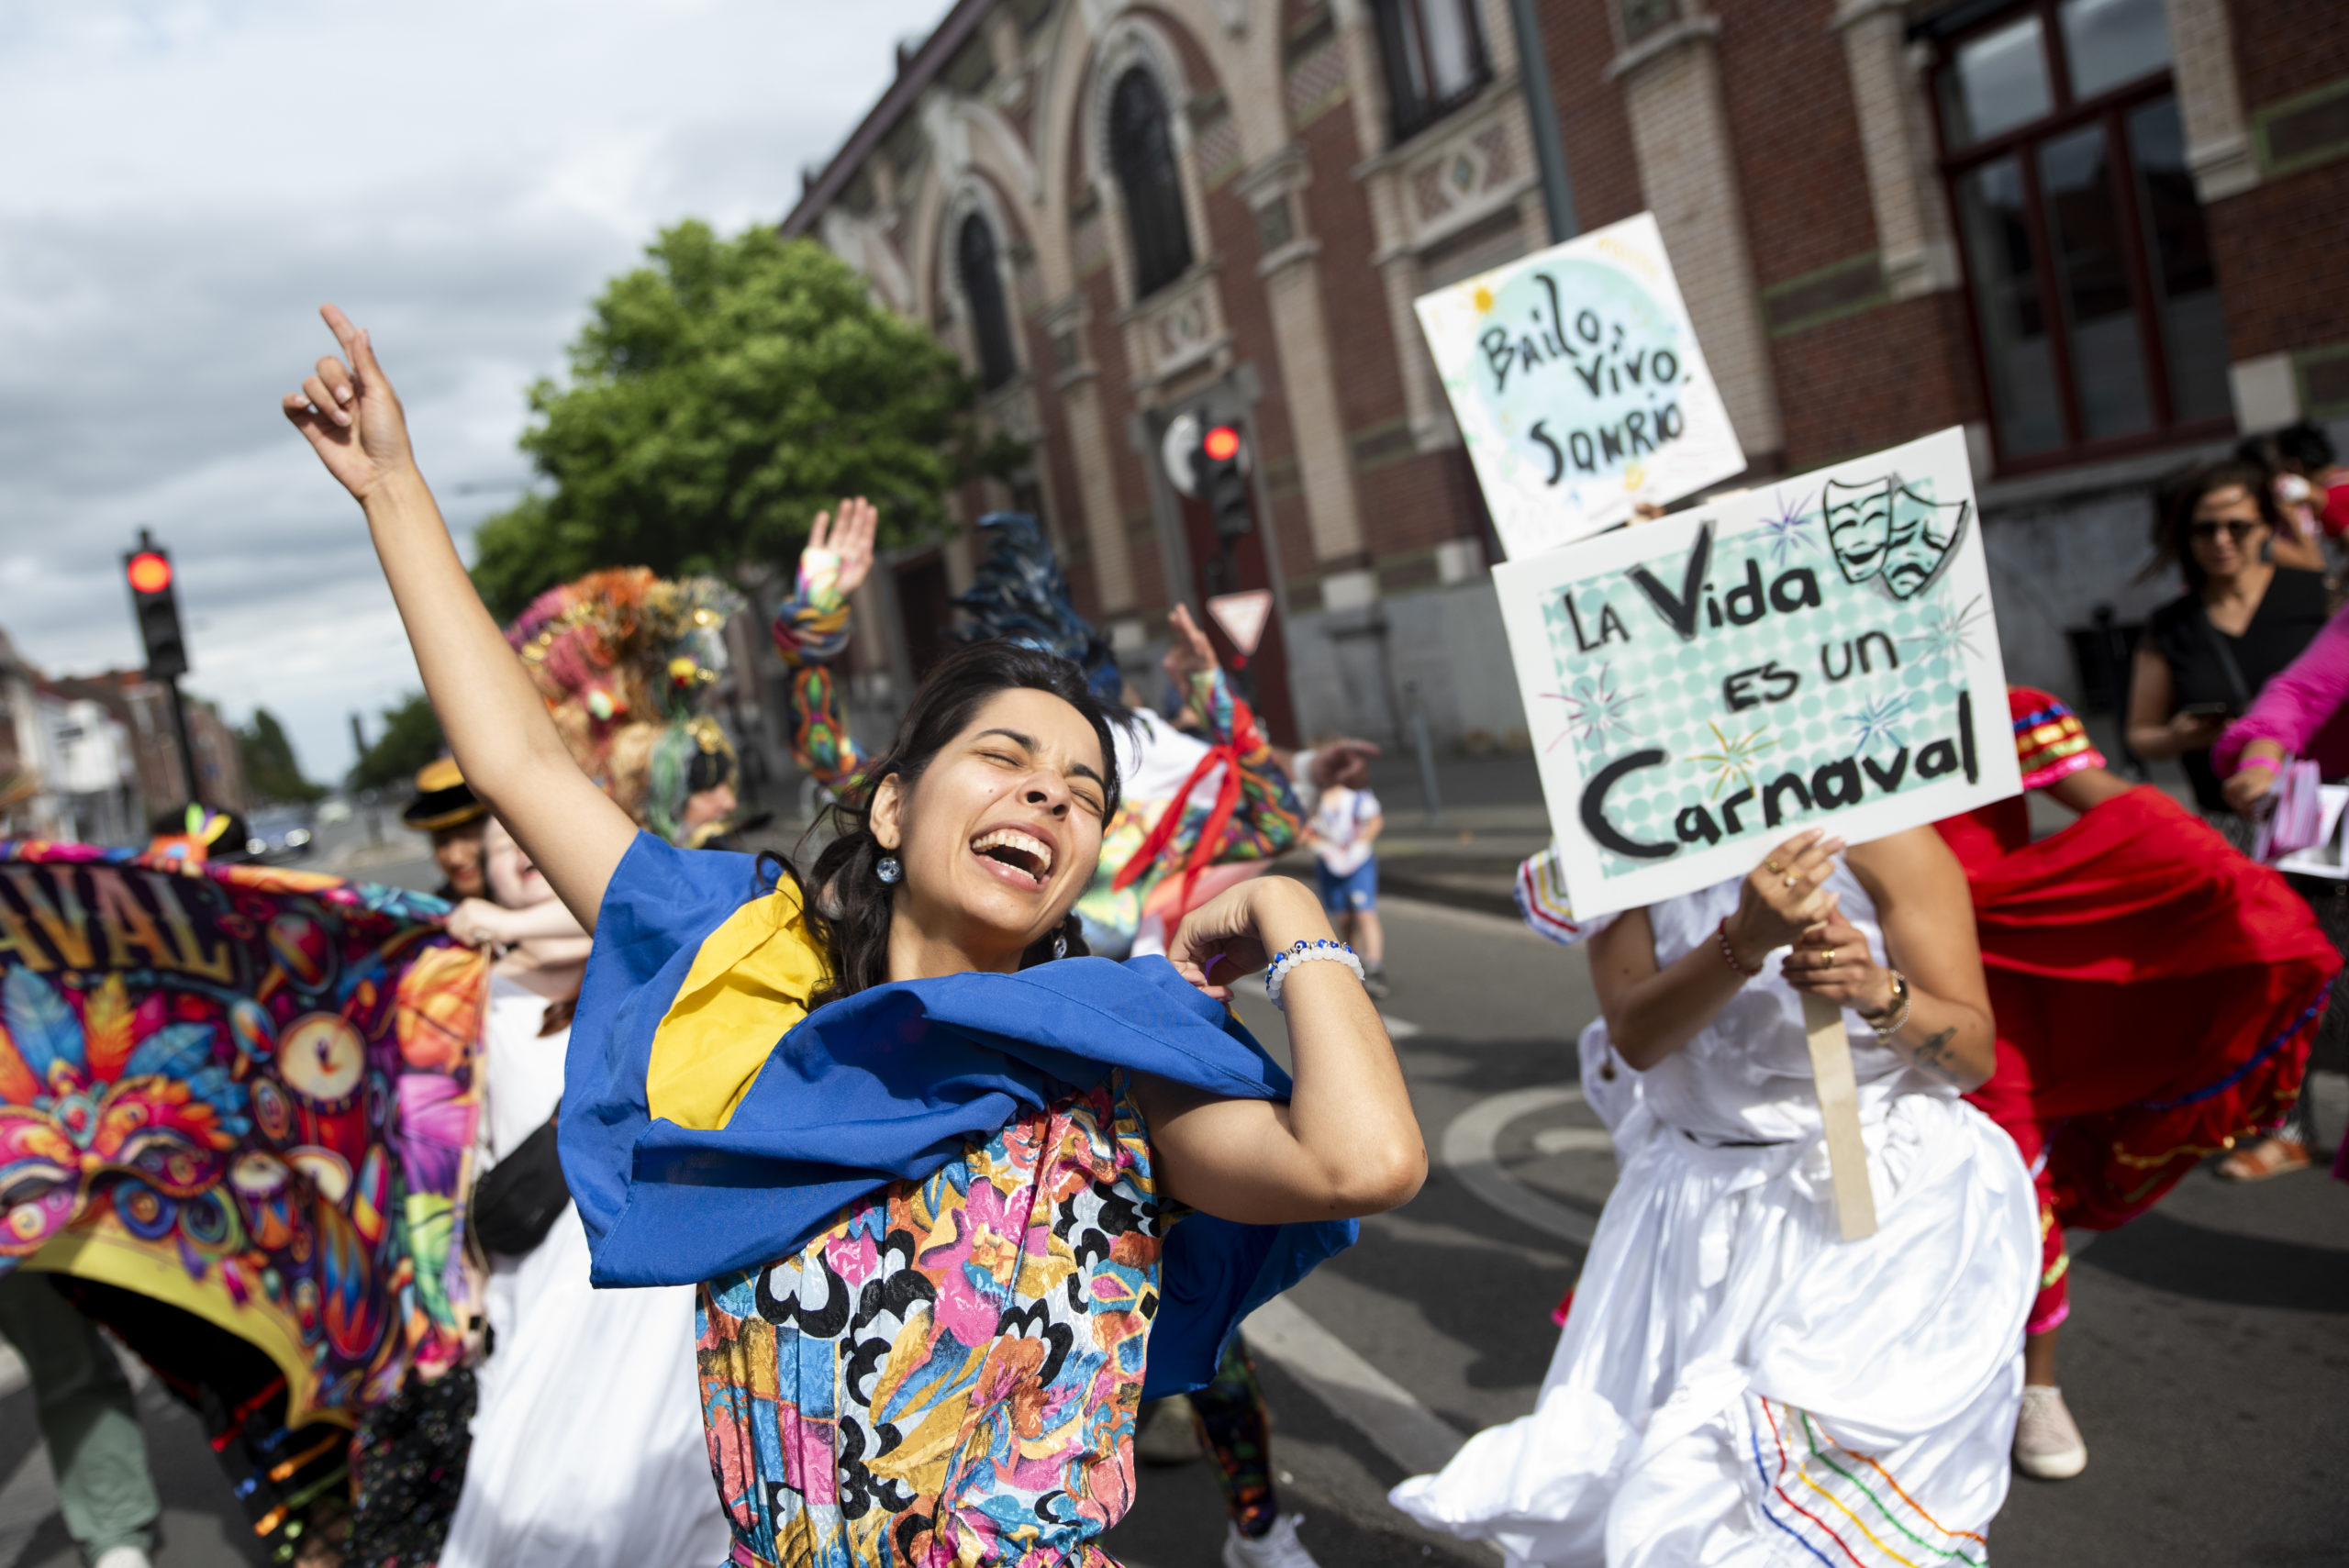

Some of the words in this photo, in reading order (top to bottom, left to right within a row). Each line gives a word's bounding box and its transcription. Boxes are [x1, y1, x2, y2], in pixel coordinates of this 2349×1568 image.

[1564, 590, 1631, 653] LA
[1624, 519, 1822, 642] Vida
[1579, 690, 1980, 861] Carnaval
